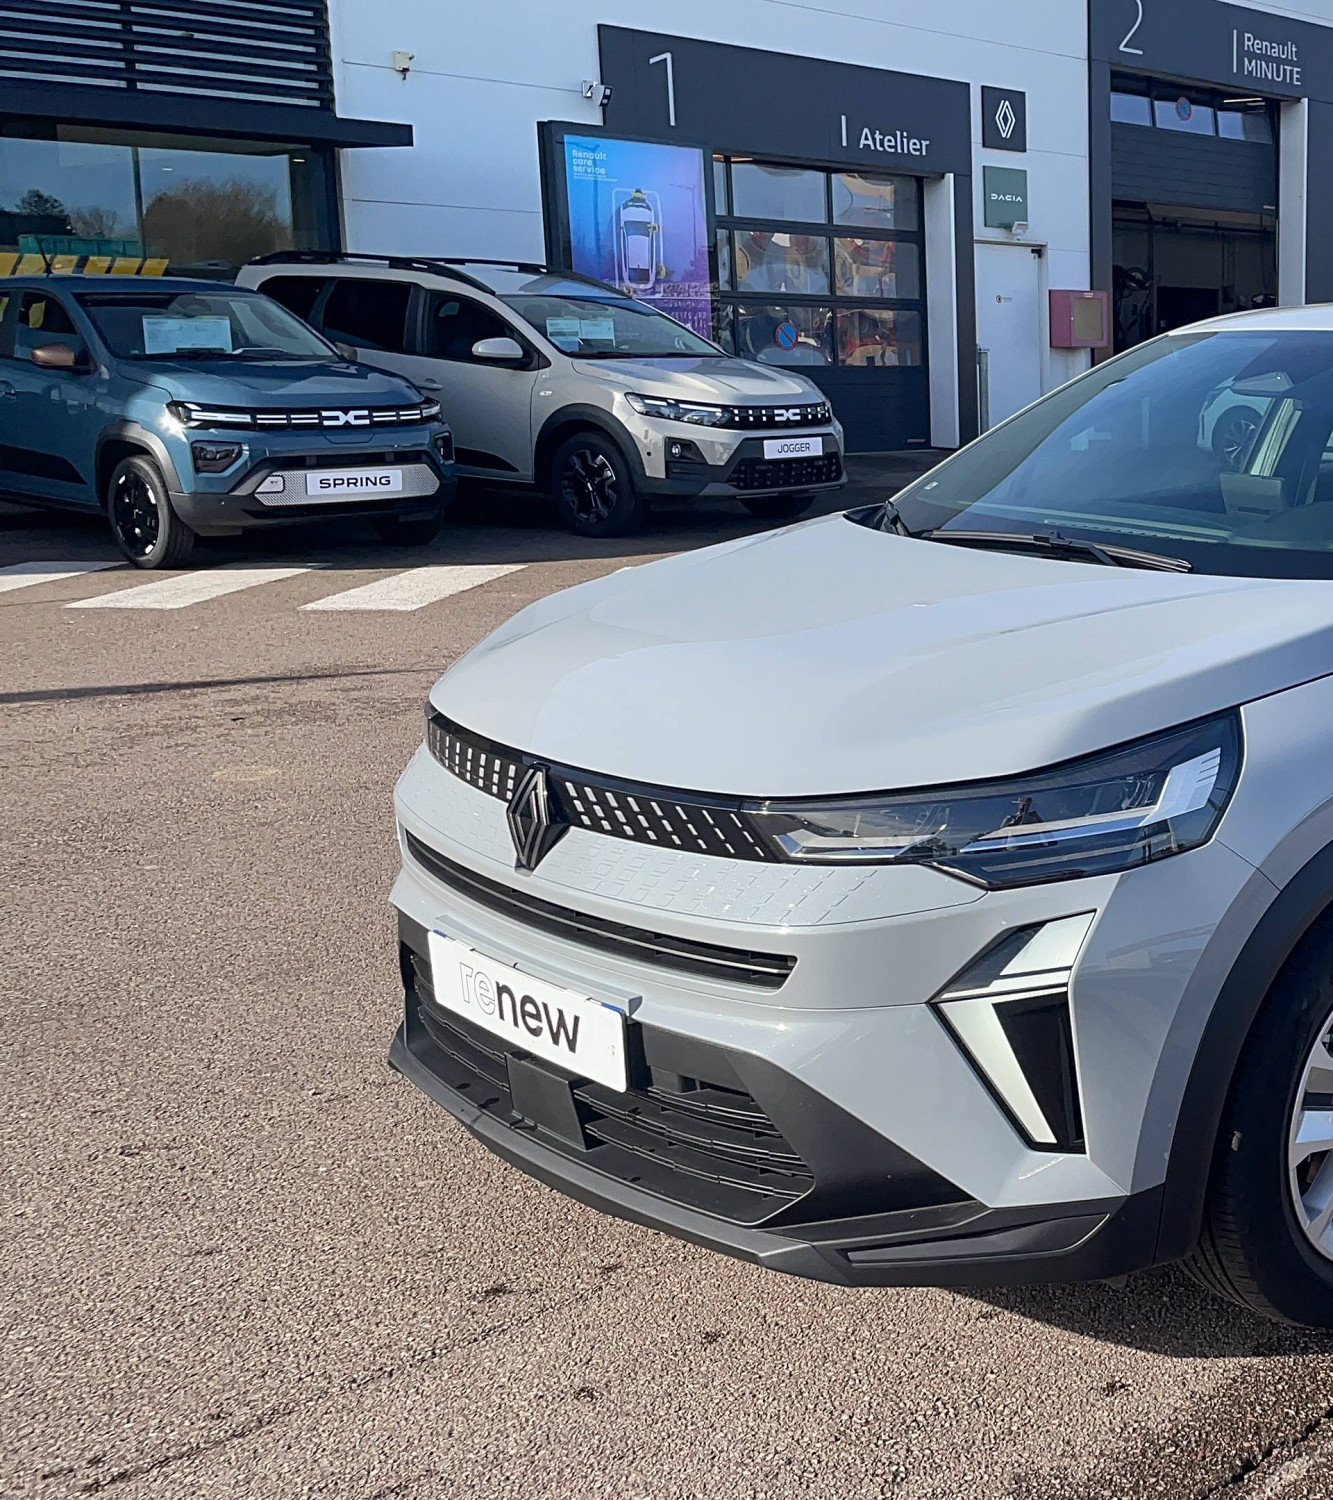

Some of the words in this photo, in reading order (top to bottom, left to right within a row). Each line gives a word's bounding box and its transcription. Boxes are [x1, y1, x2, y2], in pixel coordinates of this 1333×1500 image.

[1118, 0, 1144, 55] 2
[1243, 33, 1298, 61] Renault
[1243, 57, 1302, 86] MINUTE
[649, 51, 676, 127] 1
[571, 149, 607, 161] Renault
[858, 127, 931, 156] Atelier
[572, 164, 606, 175] service
[990, 193, 1023, 203] DACIA
[777, 442, 811, 454] JOGGER
[319, 475, 391, 489] SPRING
[459, 962, 580, 1054] renew
